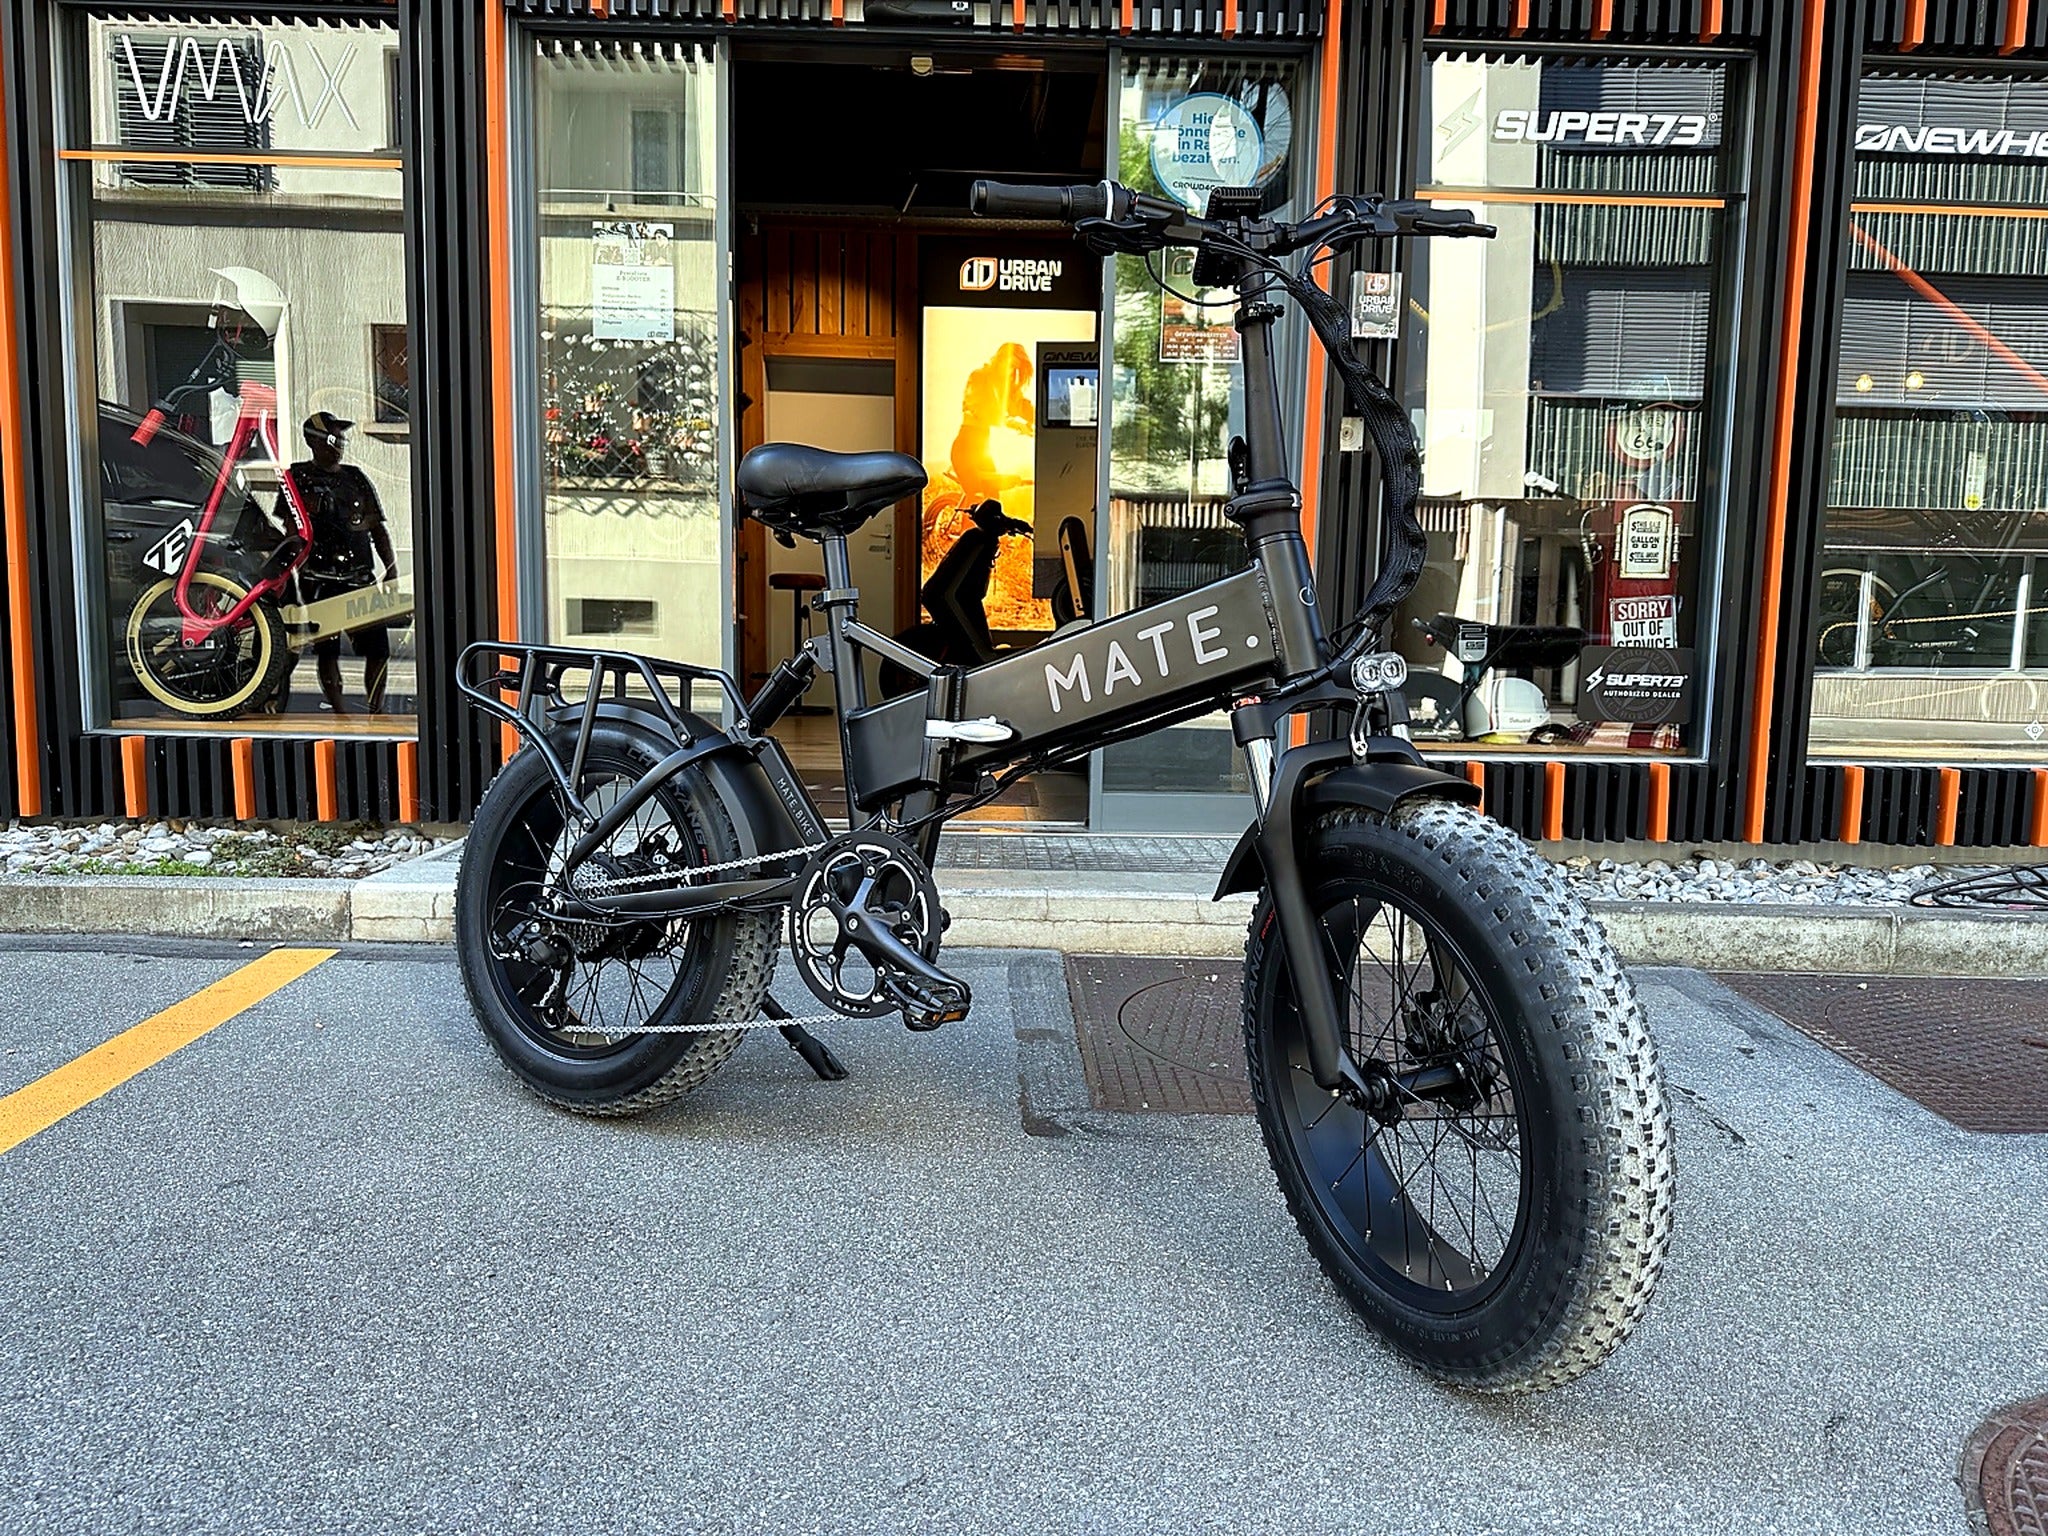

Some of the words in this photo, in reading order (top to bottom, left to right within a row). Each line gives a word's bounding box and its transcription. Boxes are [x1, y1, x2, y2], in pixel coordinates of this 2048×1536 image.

[121, 35, 358, 131] VMAX
[1193, 113, 1213, 124] Hie
[1194, 140, 1210, 150] Ra
[1000, 259, 1062, 277] URBAN
[1000, 275, 1052, 291] DRIVE
[1359, 295, 1395, 305] URBAN
[1361, 304, 1393, 314] DRIVE
[1618, 600, 1668, 620] SORRY
[1623, 621, 1645, 638] OUT
[1648, 620, 1664, 636] OF
[1045, 605, 1260, 713] MATE.
[1603, 690, 1650, 698] AUTHORIZED
[1652, 691, 1681, 699] DEALER
[776, 777, 815, 837] MATE.BIKE
[1247, 937, 1265, 1104] CHAOYANG
